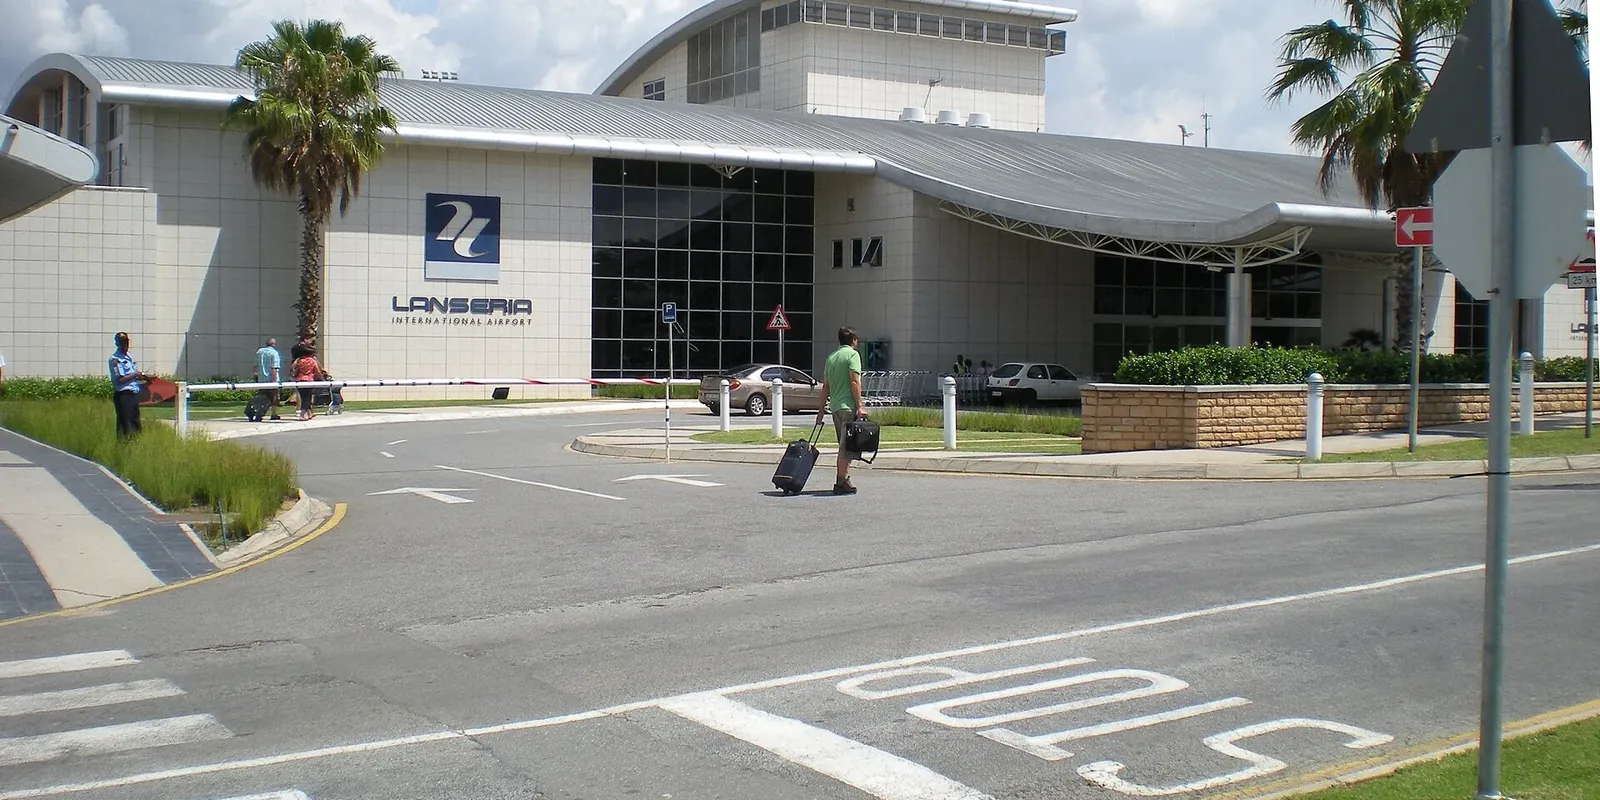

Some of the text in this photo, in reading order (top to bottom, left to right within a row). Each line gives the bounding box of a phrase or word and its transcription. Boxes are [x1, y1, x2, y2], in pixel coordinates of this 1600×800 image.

[1572, 275, 1583, 285] 25
[392, 296, 532, 316] LANSERIA
[665, 304, 673, 313] P
[391, 316, 533, 327] INTERNATIONAL AIRPORT
[836, 656, 1394, 797] STOP
